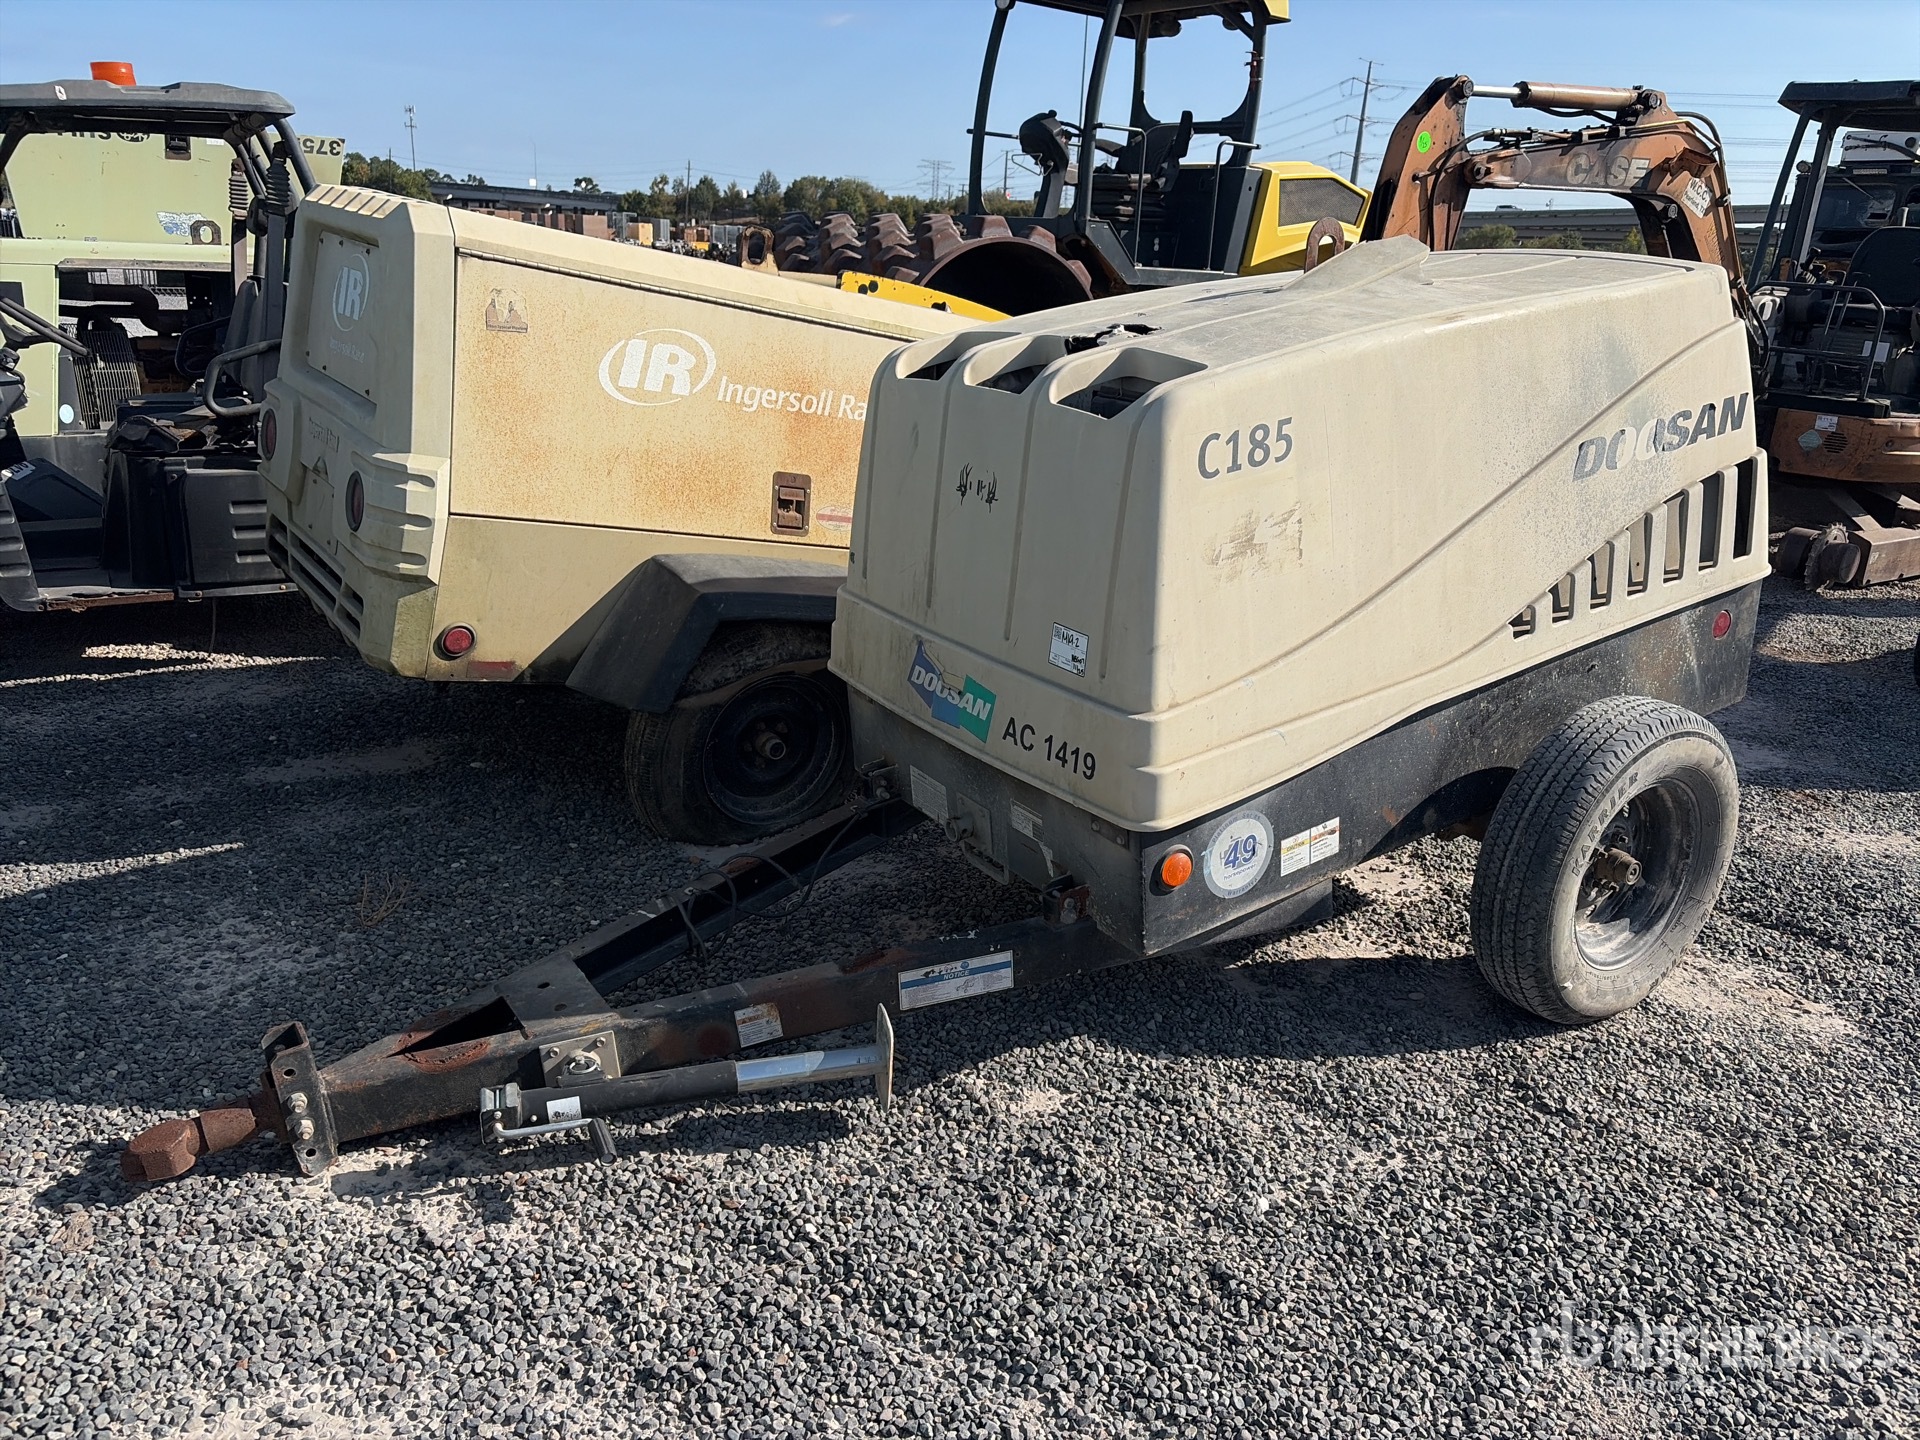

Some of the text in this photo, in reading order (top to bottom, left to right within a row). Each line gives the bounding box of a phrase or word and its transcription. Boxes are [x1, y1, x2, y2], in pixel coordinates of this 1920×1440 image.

[1566, 153, 1651, 187] CASE
[338, 266, 364, 321] IR
[618, 338, 697, 397] IR
[716, 375, 833, 416] Ingersoll
[1198, 416, 1293, 479] C185
[1572, 392, 1750, 482] DOOSAN
[911, 665, 992, 721] DOOSAN
[1002, 716, 1097, 781] AC 1419
[1223, 833, 1258, 869] 49
[1571, 771, 1640, 878] KARRIER
[943, 970, 970, 981] NOTICE
